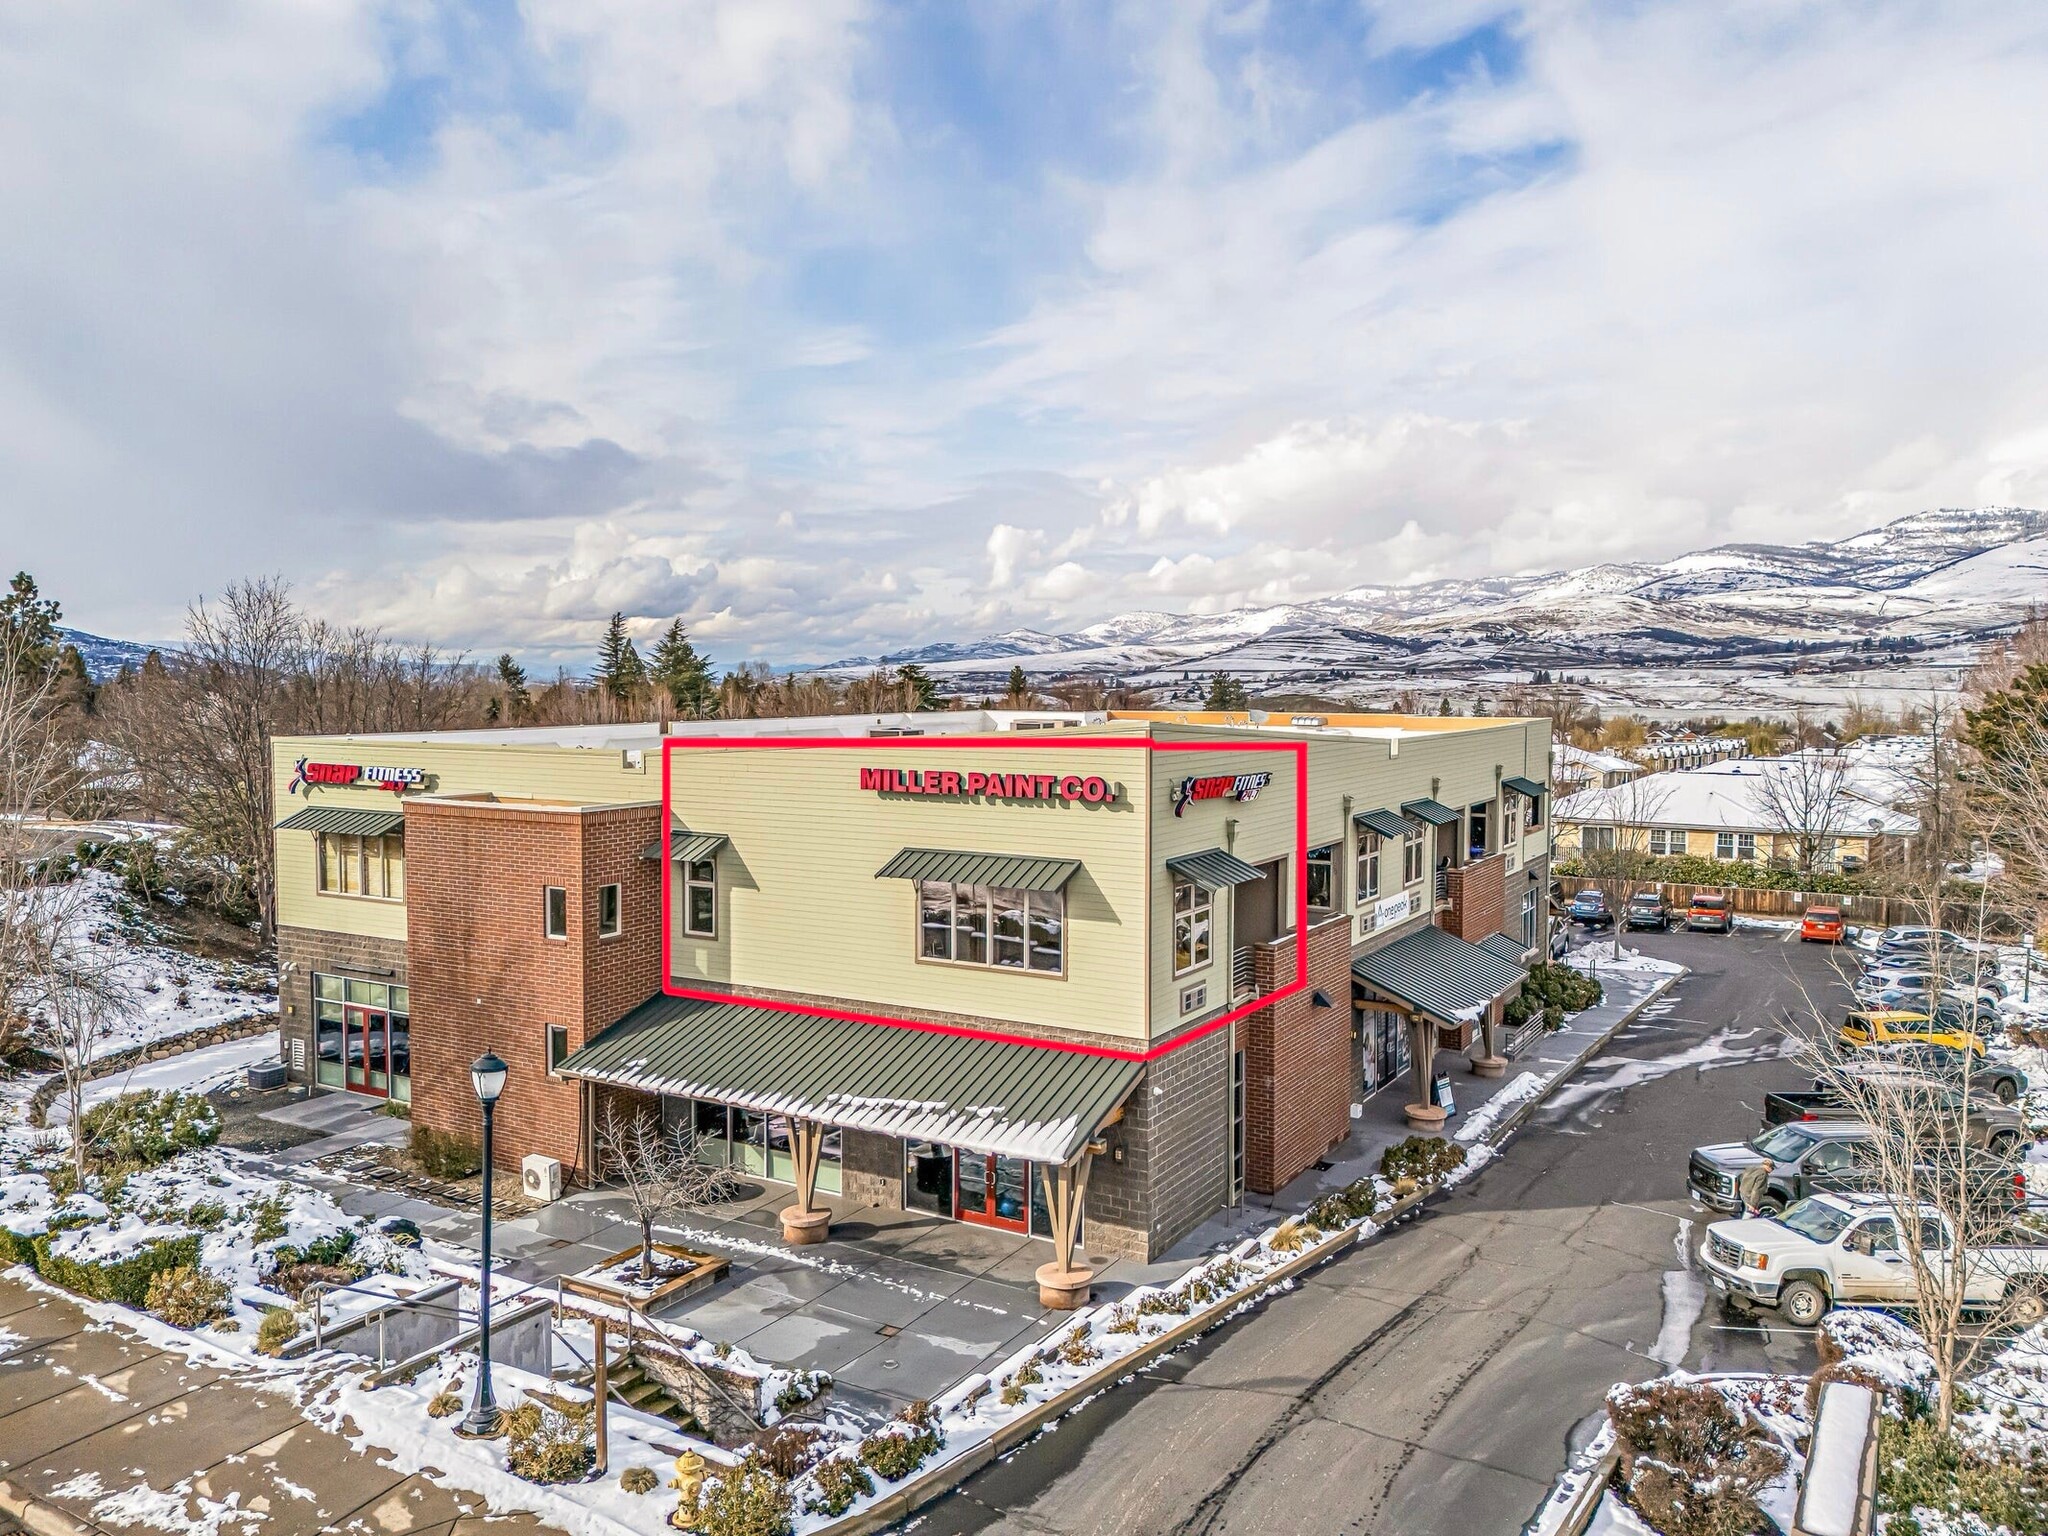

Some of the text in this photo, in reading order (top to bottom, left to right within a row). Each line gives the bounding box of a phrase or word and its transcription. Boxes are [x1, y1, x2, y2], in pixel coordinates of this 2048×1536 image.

[364, 767, 422, 783] FITNESS
[860, 768, 1116, 803] MILLER PAINT CO.
